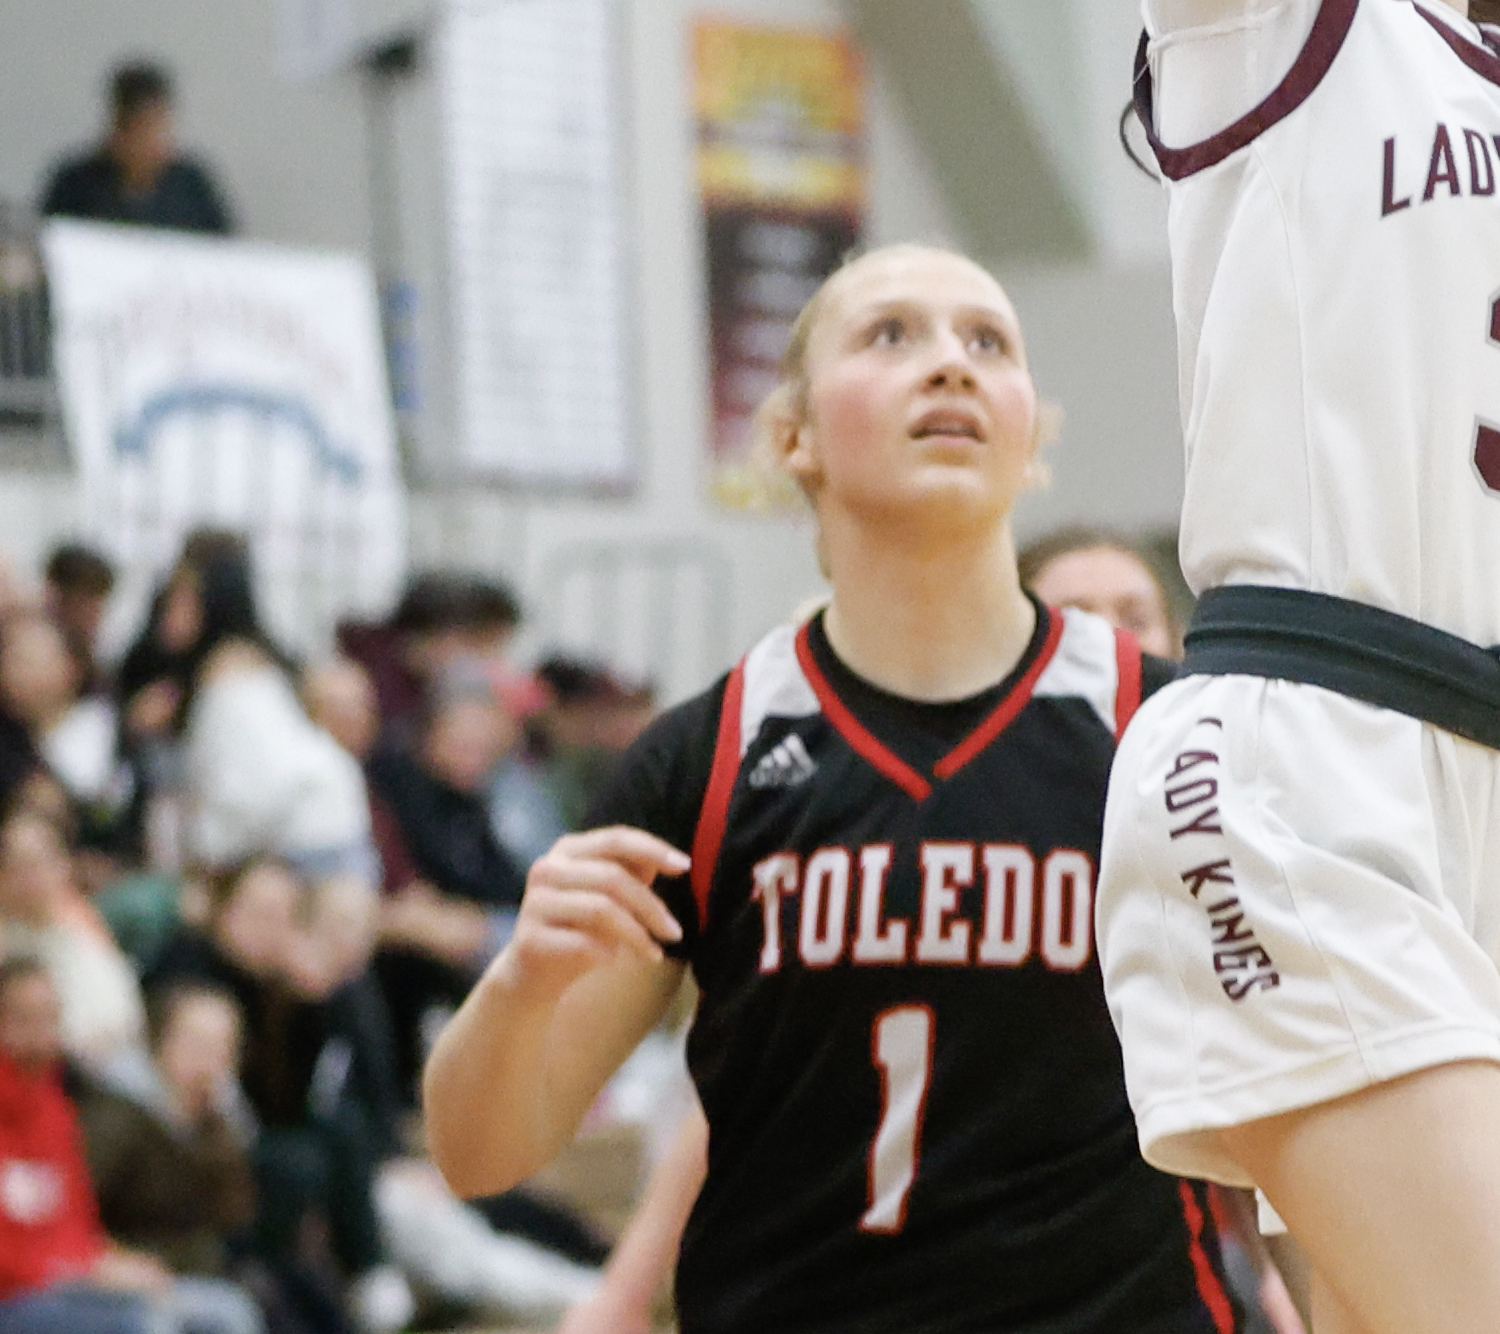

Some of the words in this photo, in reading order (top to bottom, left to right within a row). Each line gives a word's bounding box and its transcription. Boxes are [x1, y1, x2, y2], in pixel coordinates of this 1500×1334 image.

[751, 840, 1096, 973] TOLEDO
[1180, 859, 1280, 1003] KINGS
[860, 1002, 936, 1235] 1
